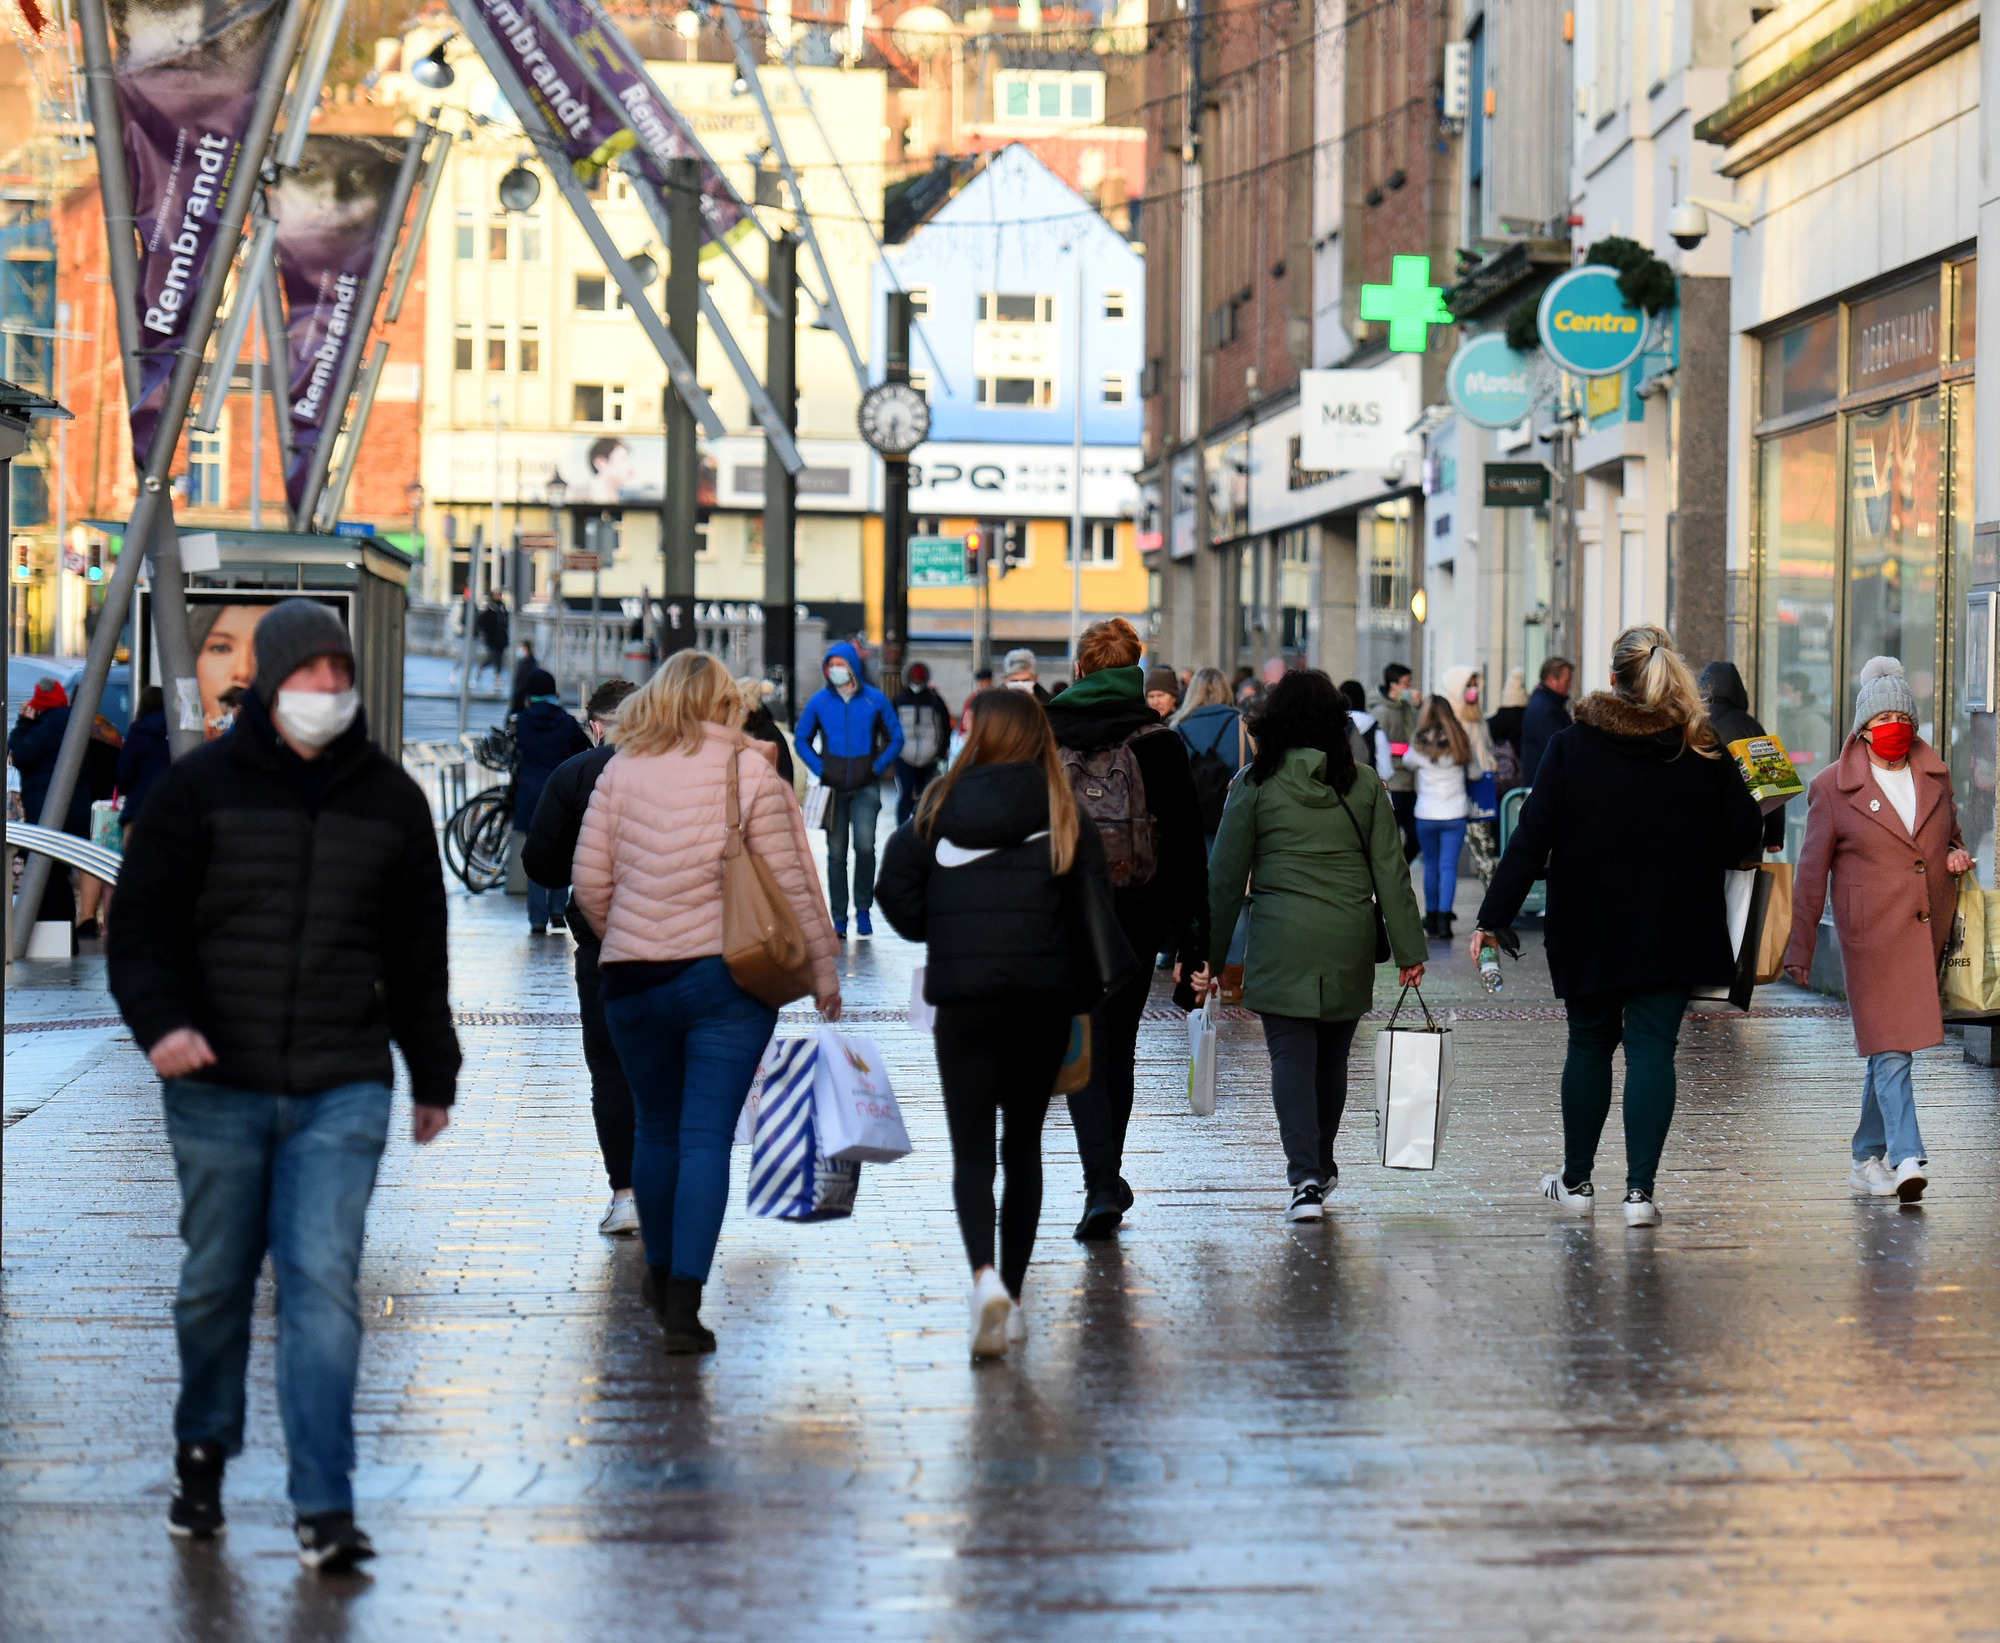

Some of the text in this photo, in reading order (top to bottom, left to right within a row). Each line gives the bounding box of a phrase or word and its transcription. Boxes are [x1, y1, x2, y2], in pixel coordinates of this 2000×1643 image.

[144, 132, 229, 335] Rembrandt
[293, 272, 359, 419] Rembrandt
[1553, 308, 1638, 334] Centra
[1861, 304, 1934, 375] DEBENHAMS
[1321, 402, 1383, 427] M&S
